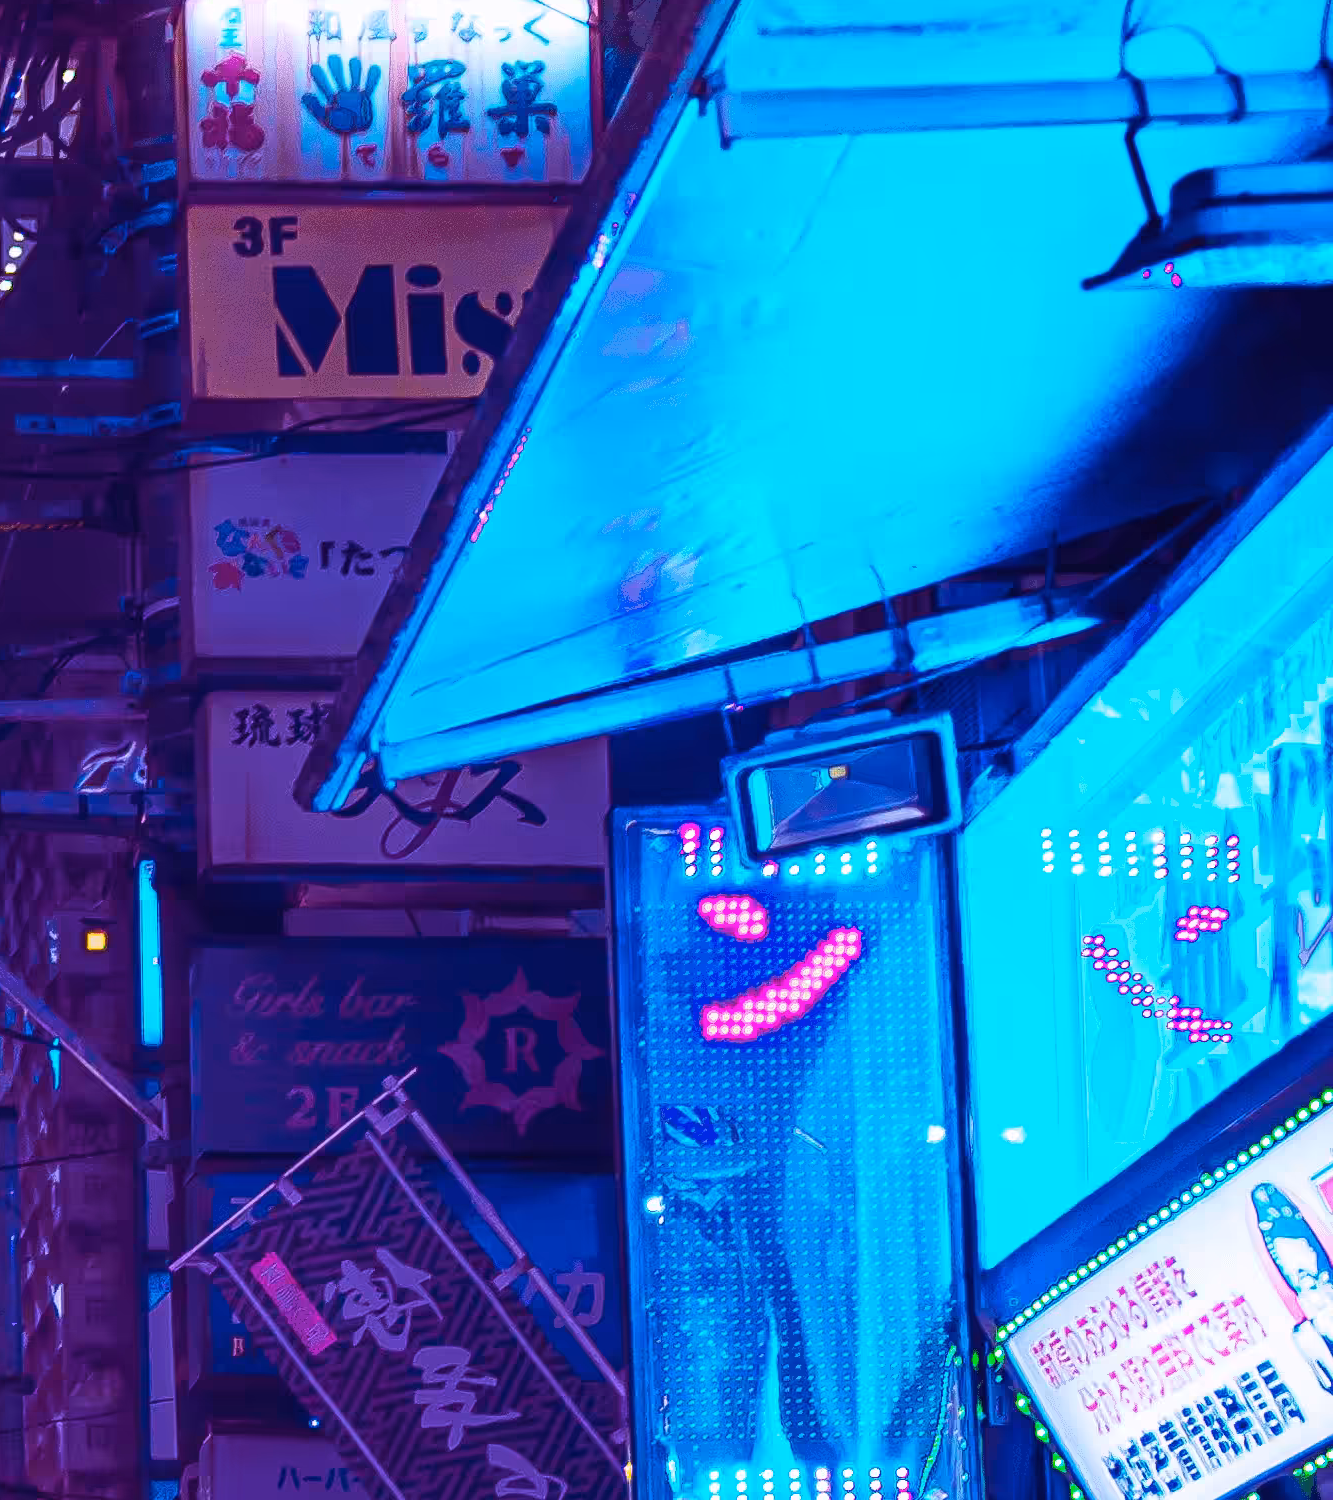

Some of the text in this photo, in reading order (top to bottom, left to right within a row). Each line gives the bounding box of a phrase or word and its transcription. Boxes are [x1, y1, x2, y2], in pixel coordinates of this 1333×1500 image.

[232, 215, 300, 259] 3F
[340, 977, 418, 1021] bar
[293, 1036, 417, 1068] snack
